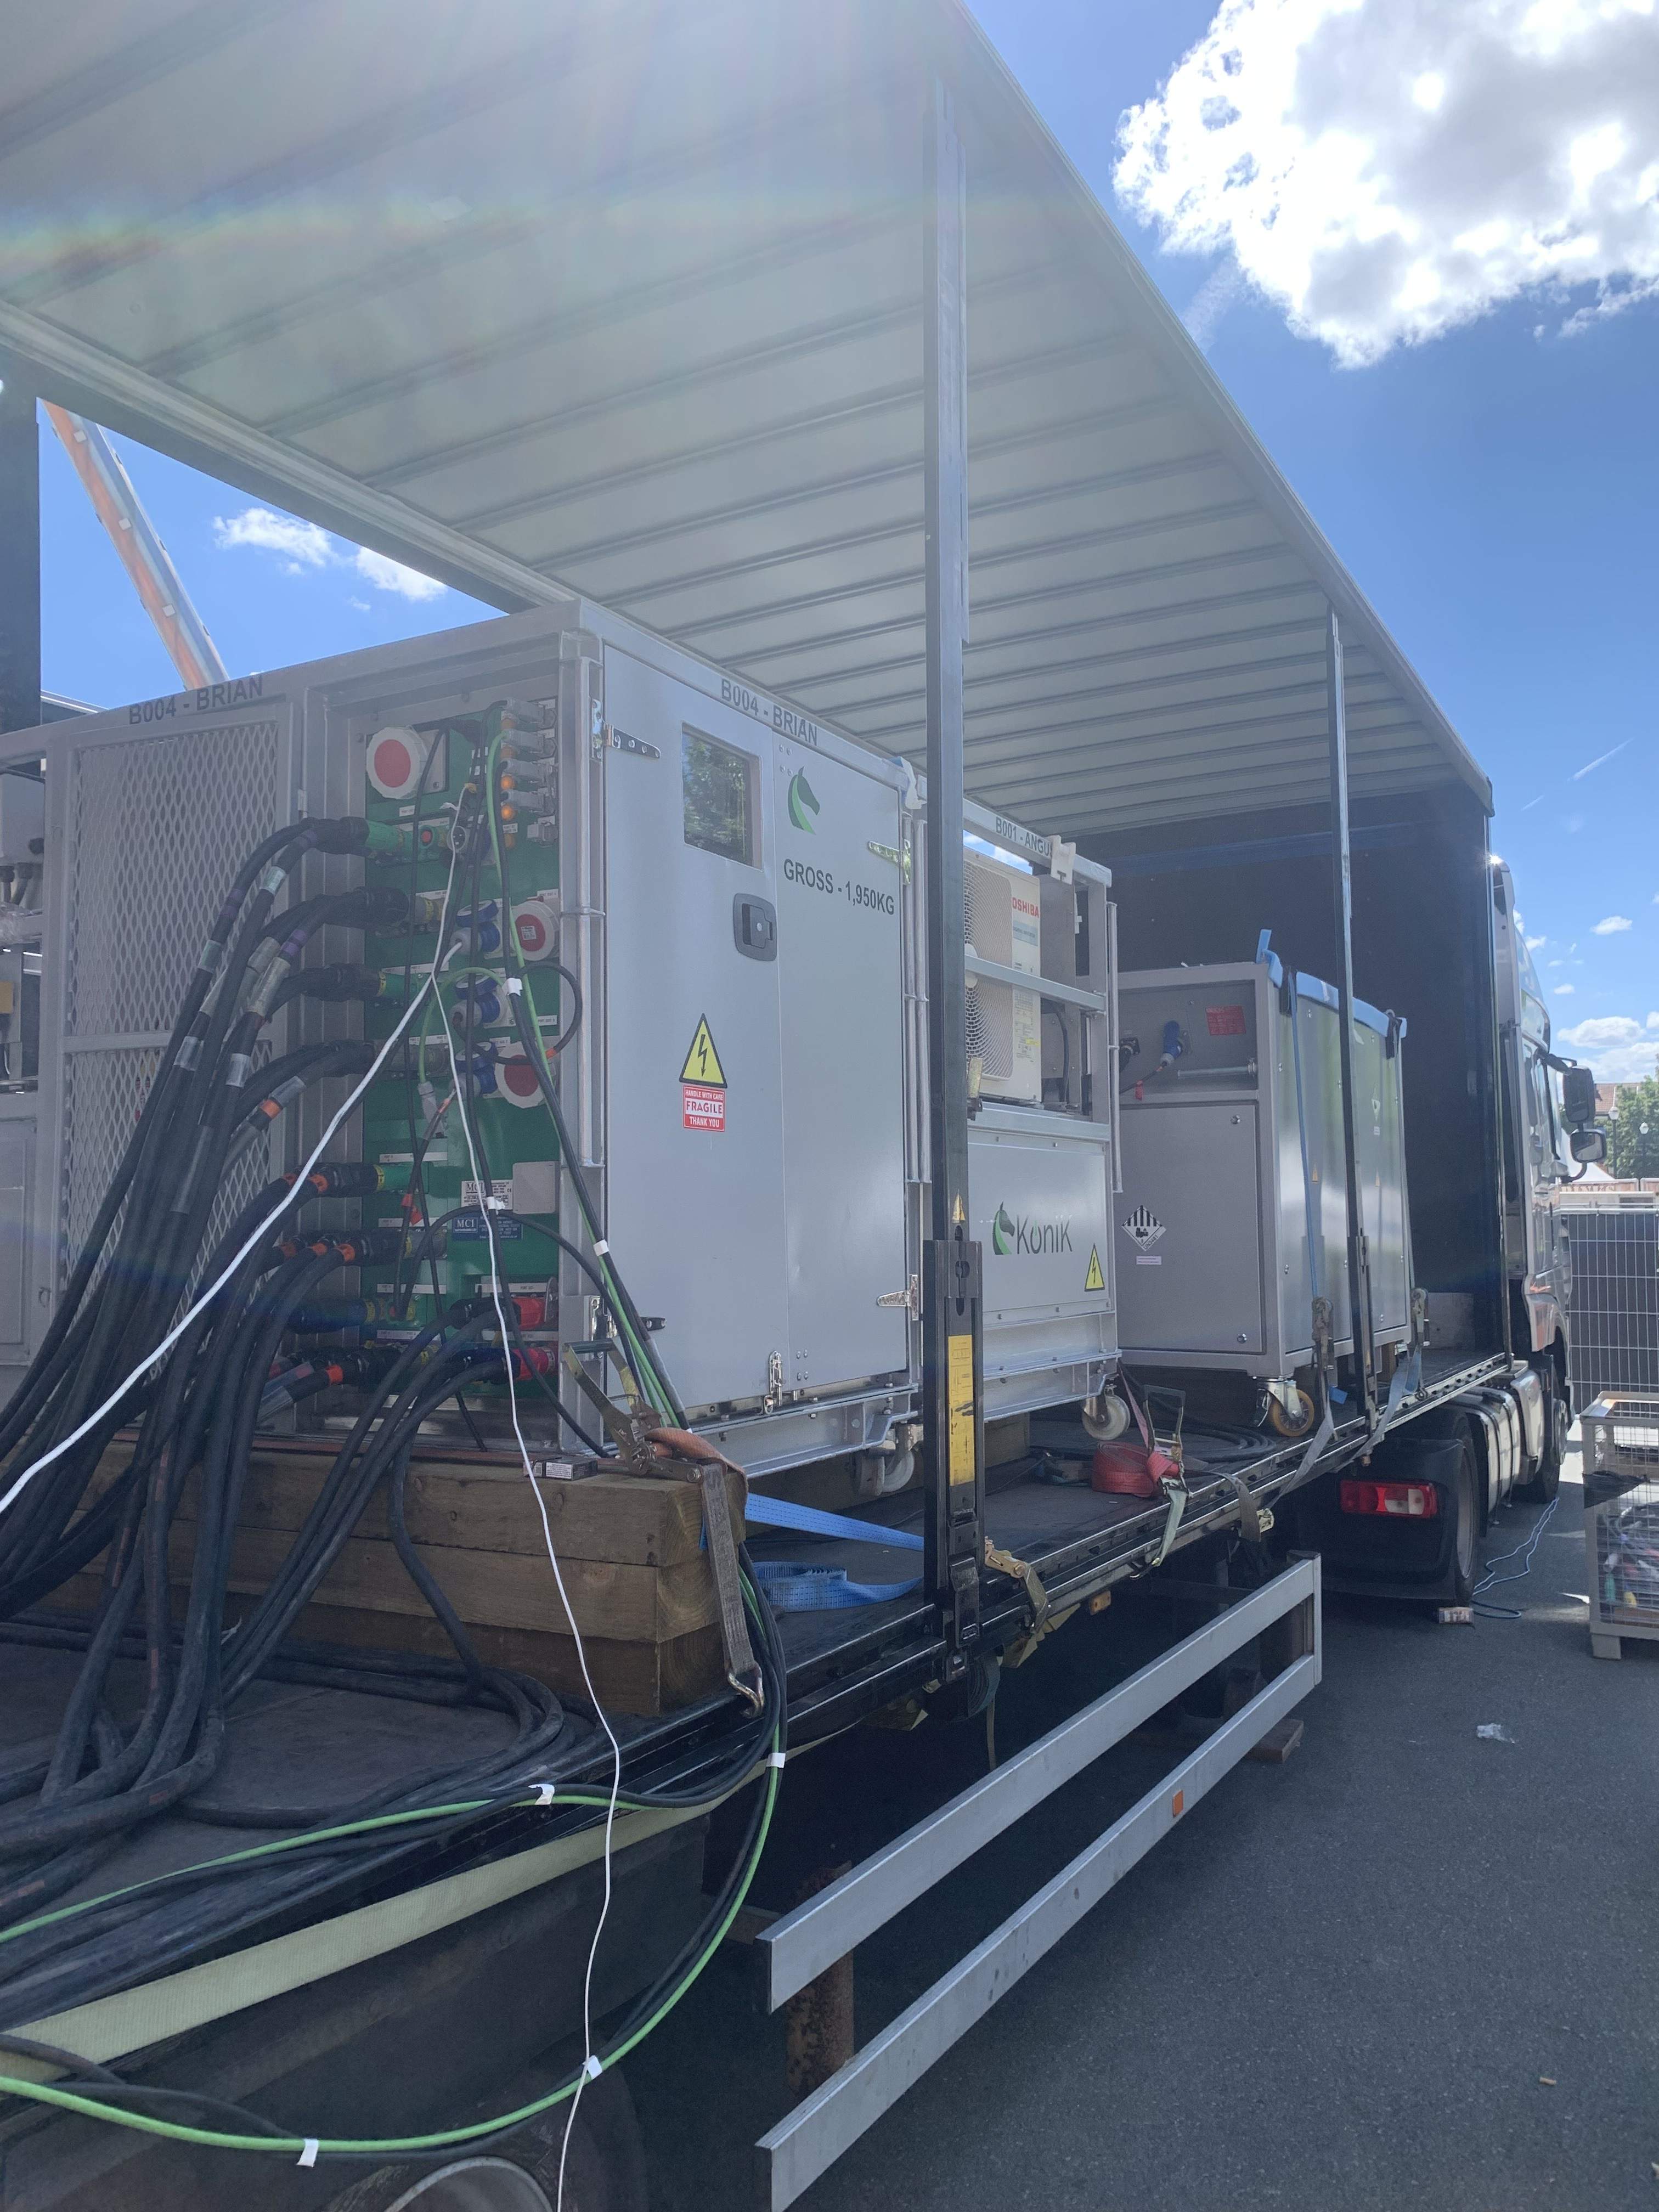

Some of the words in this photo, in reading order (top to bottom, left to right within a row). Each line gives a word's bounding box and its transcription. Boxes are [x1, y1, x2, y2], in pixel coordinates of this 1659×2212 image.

[129, 695, 176, 725] B004
[197, 675, 262, 711] BRIAN
[721, 679, 759, 715] B004
[774, 705, 817, 746] BRIAN
[996, 816, 1016, 841] B001
[784, 859, 833, 894] GROSS
[845, 881, 894, 915] 1,950KG
[1012, 897, 1039, 918] OSHIBA
[685, 1089, 701, 1097] HANDLE
[686, 1101, 722, 1114] FRAGILE
[690, 1116, 707, 1126] THANK
[709, 1118, 719, 1127] YOU
[457, 1219, 475, 1228] MCI
